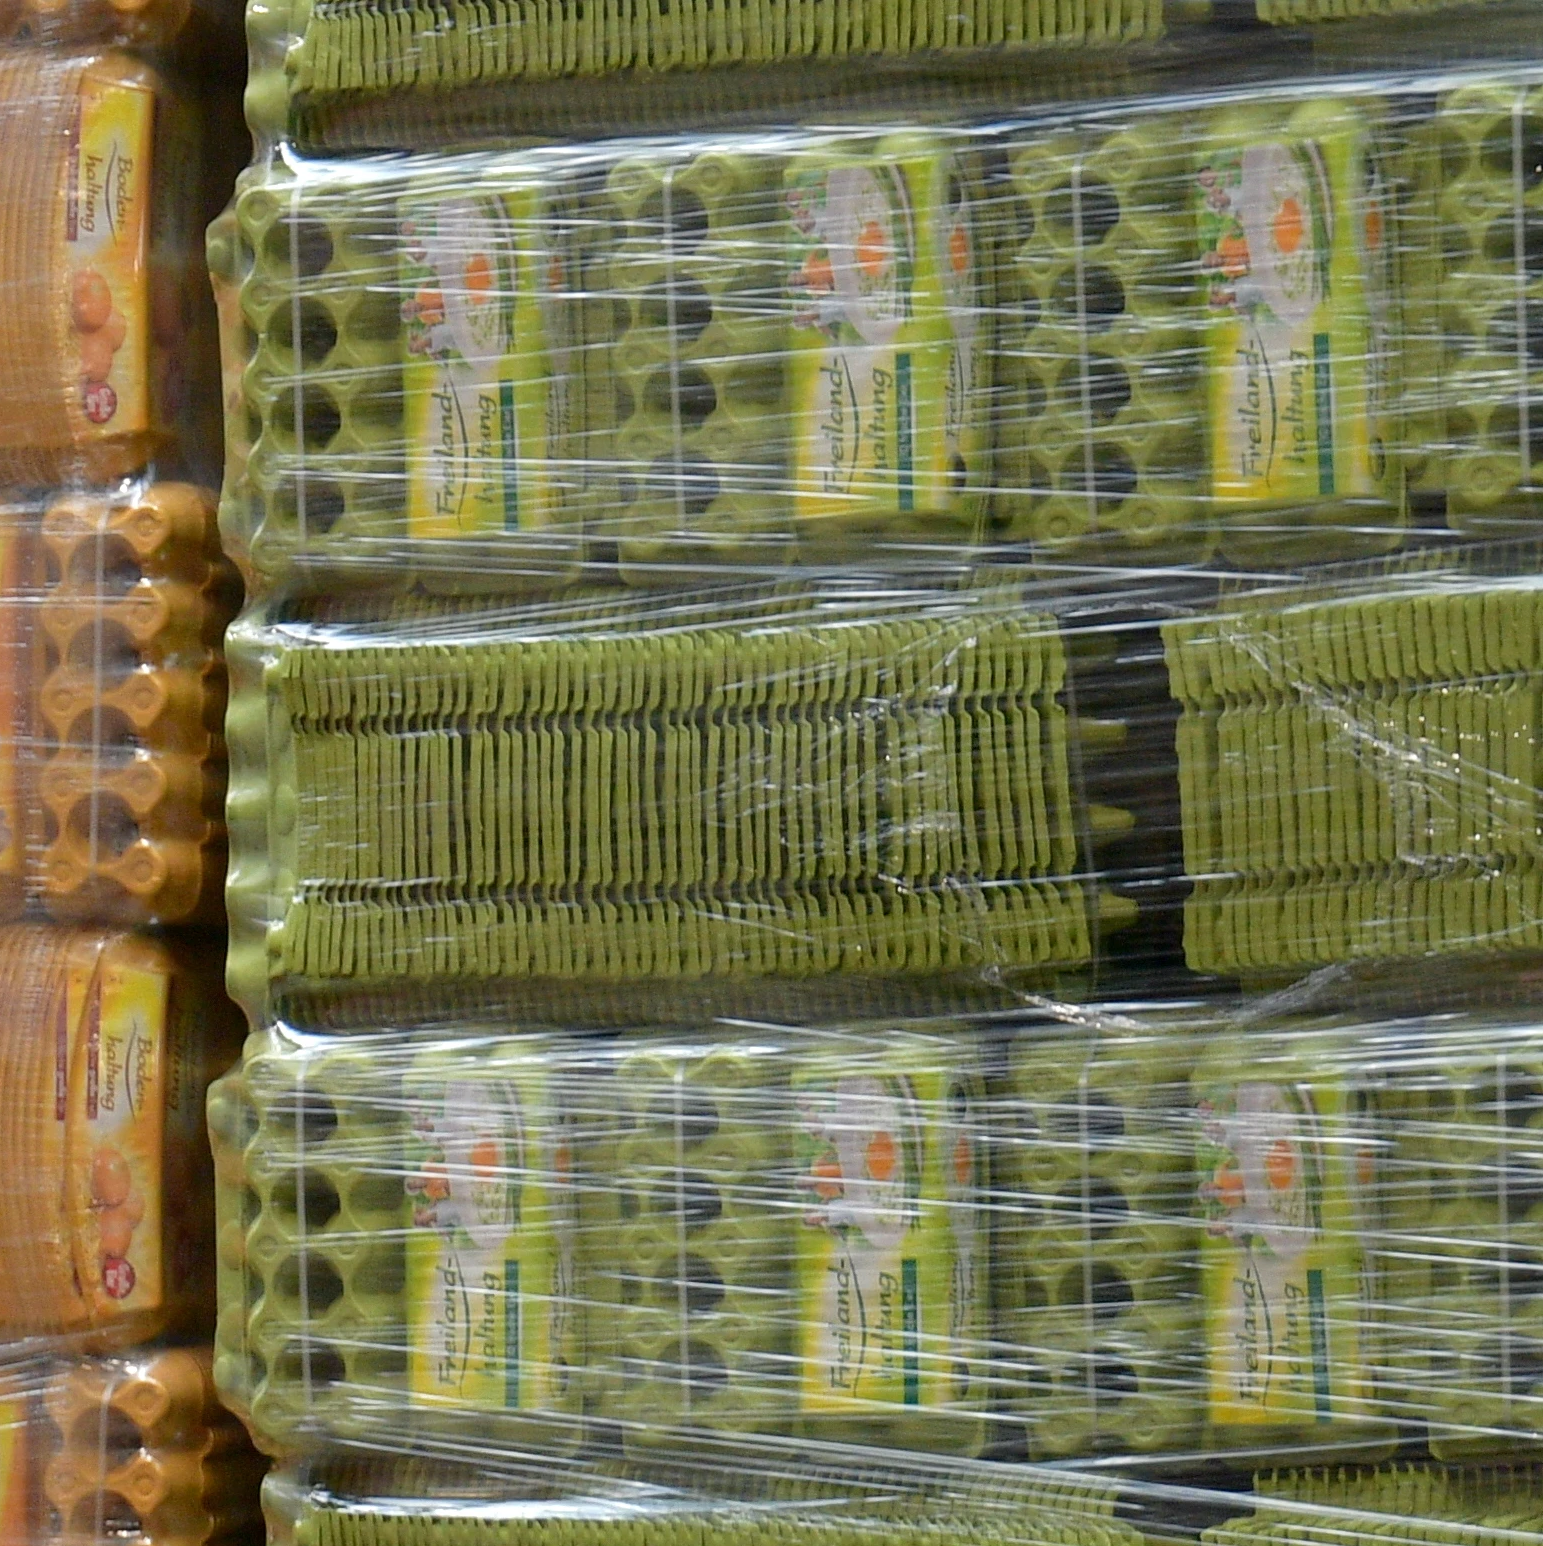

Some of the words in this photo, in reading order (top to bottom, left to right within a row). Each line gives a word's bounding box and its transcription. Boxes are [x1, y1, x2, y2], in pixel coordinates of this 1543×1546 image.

[1237, 340, 1262, 476] Freiland-
[101, 1036, 123, 1112] haltung
[135, 1036, 153, 1111] Boden-
